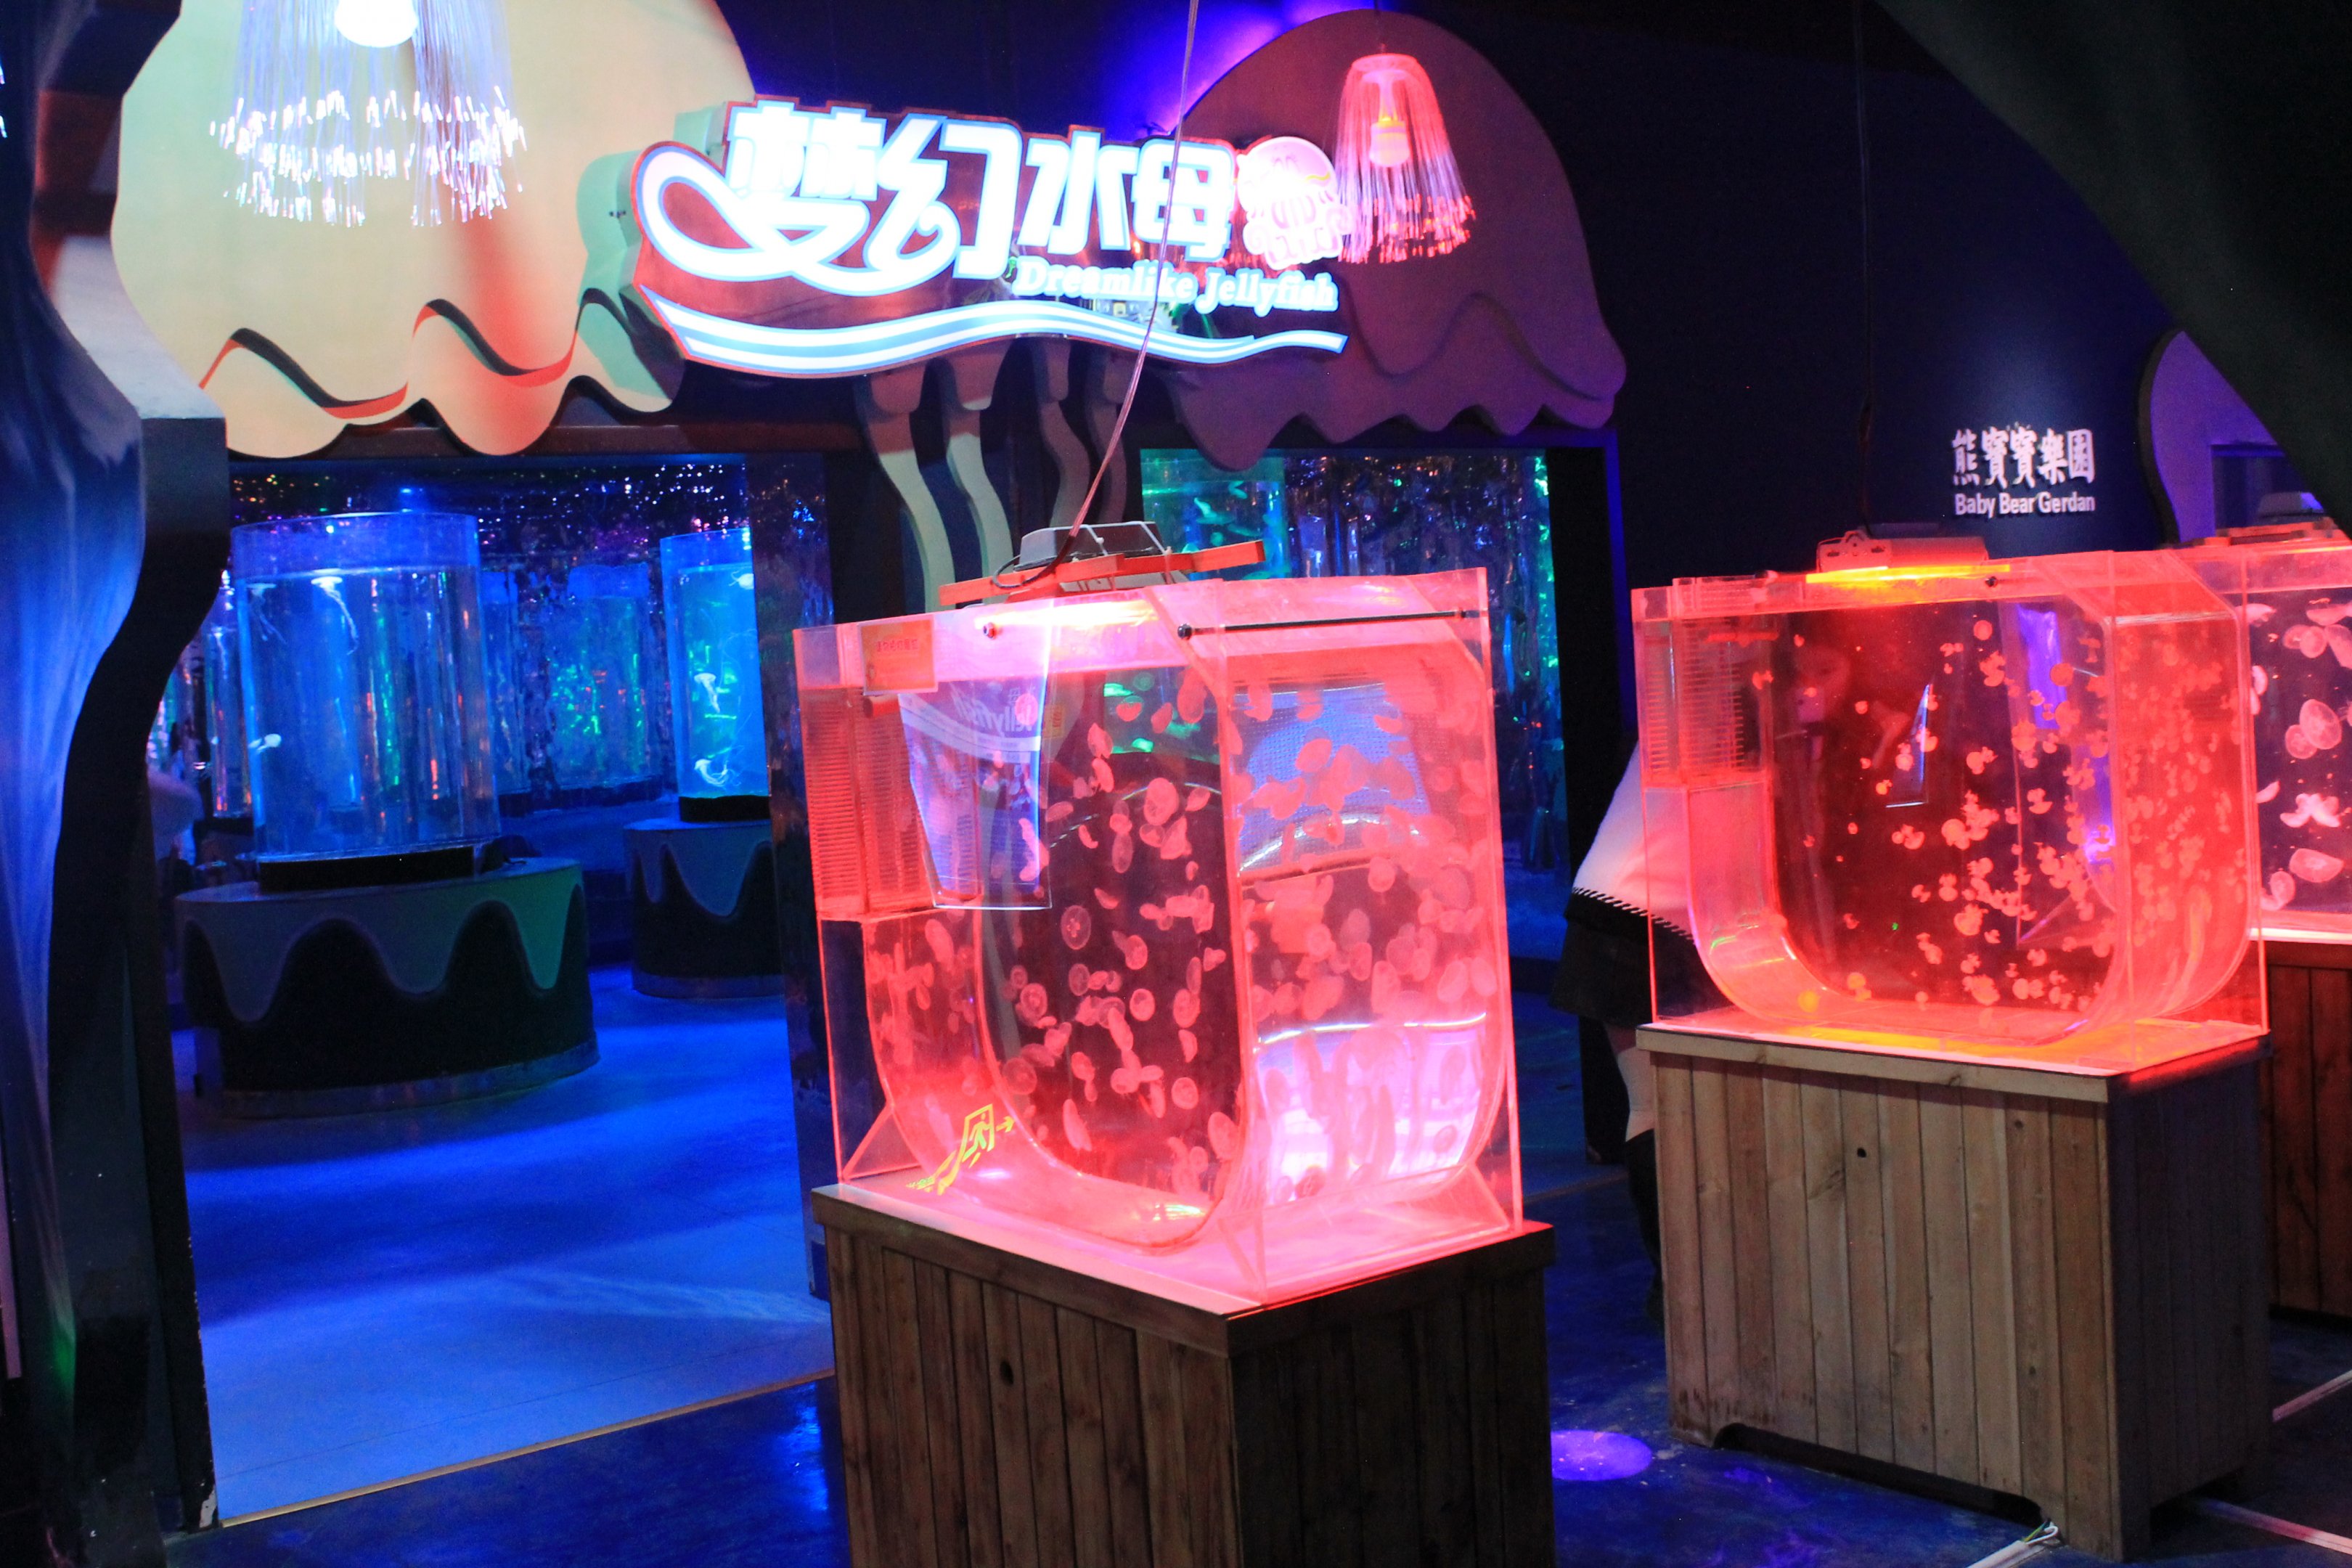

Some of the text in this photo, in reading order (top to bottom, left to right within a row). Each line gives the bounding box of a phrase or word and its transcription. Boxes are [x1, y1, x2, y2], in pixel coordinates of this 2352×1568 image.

[636, 100, 1237, 298] 梦幻水母
[1013, 256, 1338, 317] Dreamlike Jellyfish
[1954, 491, 2096, 518] Baby Bear Gerdan
